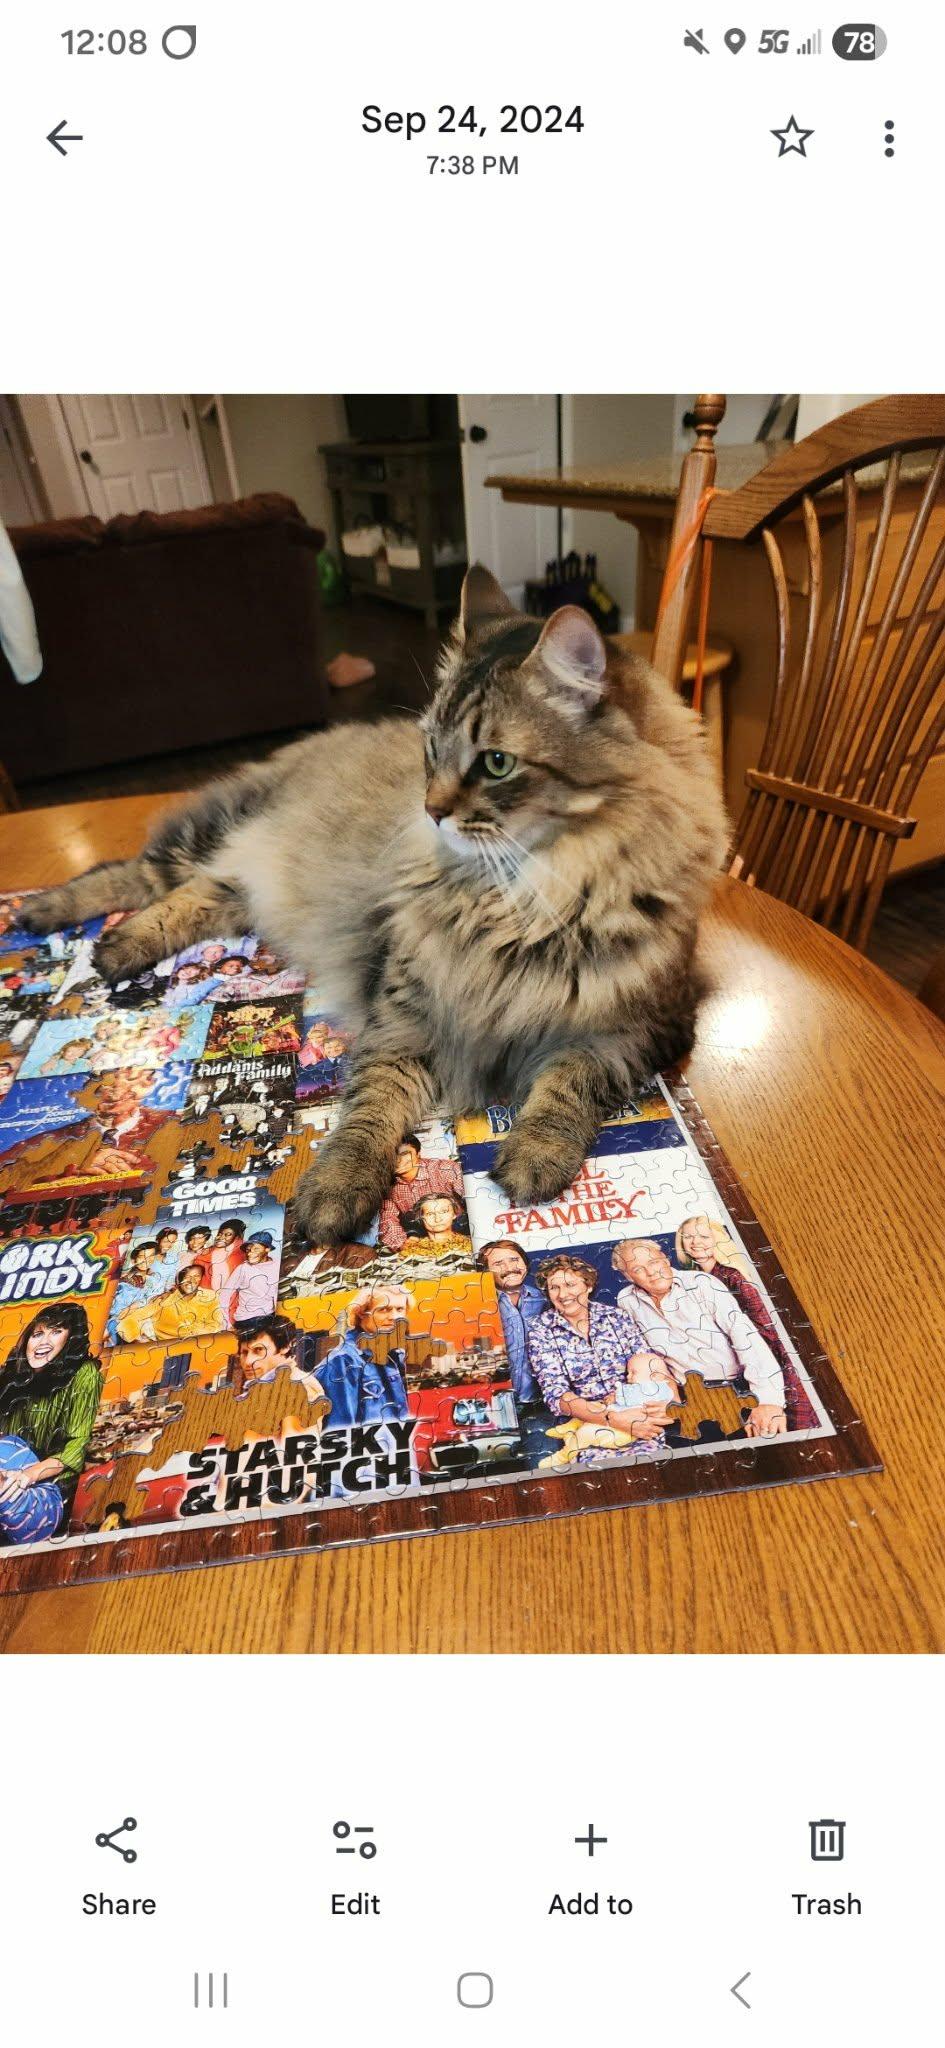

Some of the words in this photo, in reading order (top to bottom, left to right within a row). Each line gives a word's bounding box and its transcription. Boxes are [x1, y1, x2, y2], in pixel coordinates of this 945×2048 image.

[197, 1060, 264, 1079] Addams
[234, 1064, 291, 1086] Family
[172, 1176, 258, 1200] GOOD
[171, 1191, 257, 1217] TIMES
[494, 1190, 647, 1235] FAMILY
[186, 1421, 417, 1480] STARSKY
